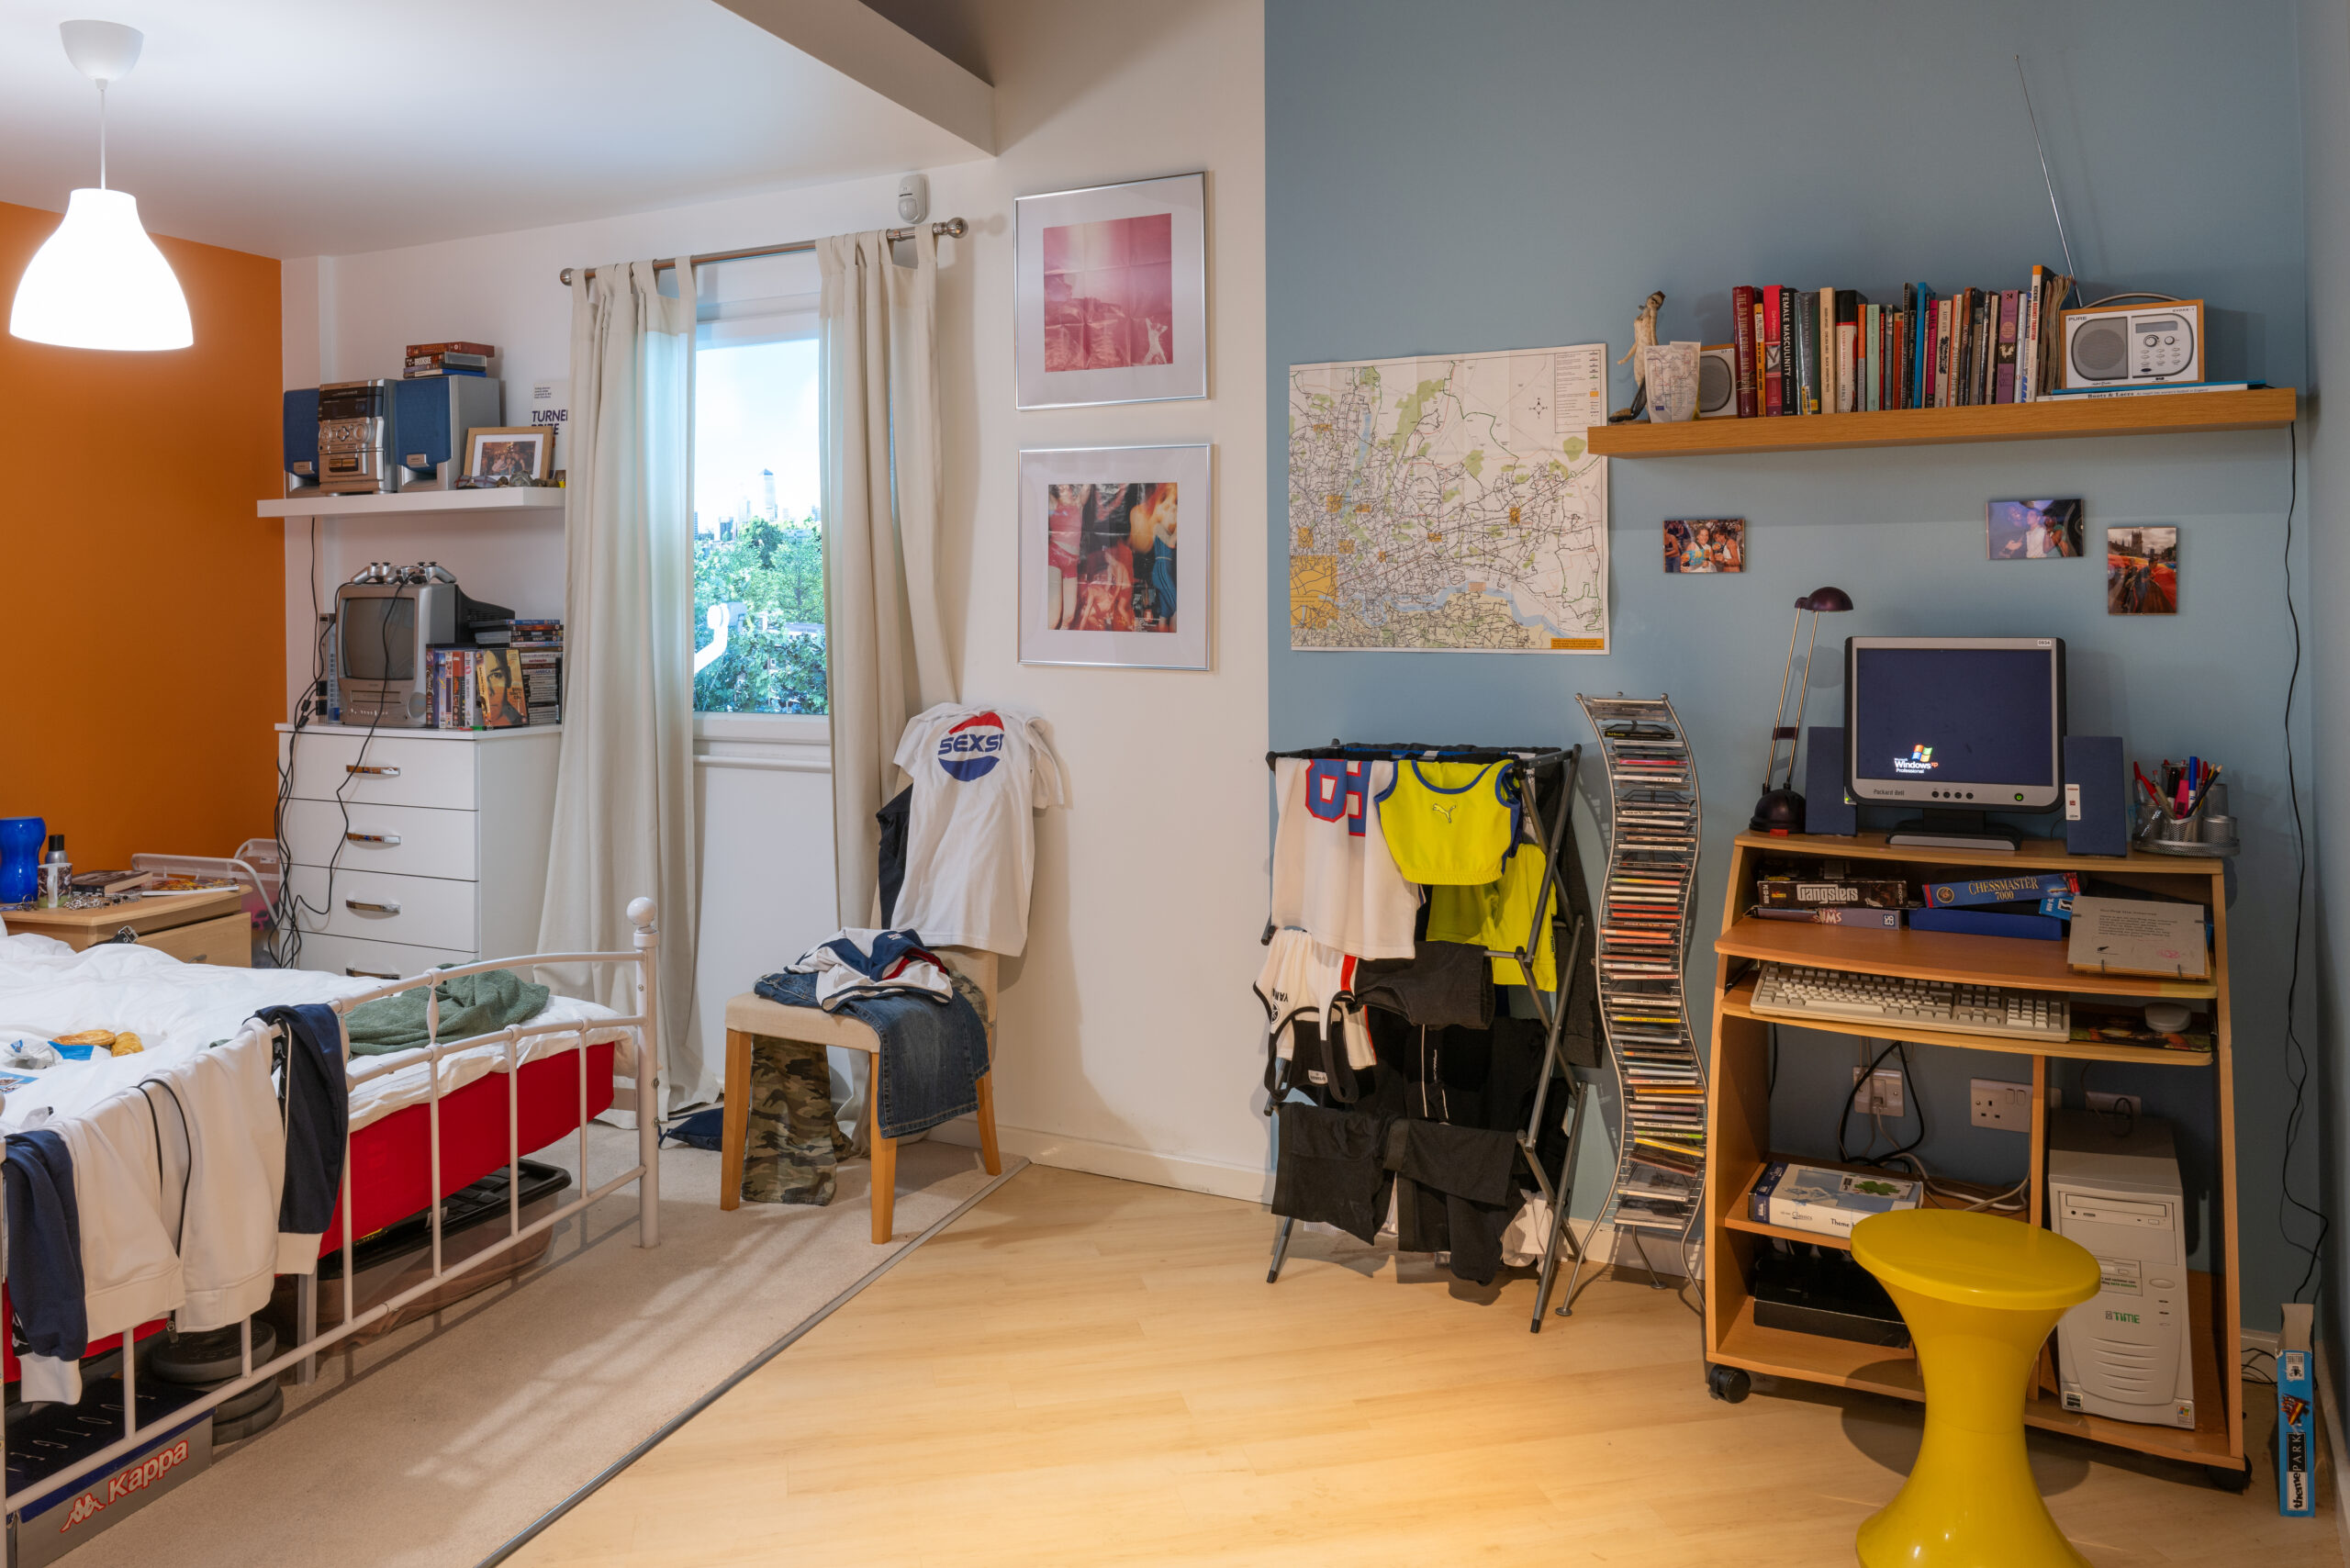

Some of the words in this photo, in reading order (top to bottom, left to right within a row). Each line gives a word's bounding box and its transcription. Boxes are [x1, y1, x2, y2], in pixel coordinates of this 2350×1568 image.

[1782, 292, 1791, 322] FEMALE
[1783, 324, 1791, 376] MASCULINITY
[937, 734, 1005, 756] SEXSI
[1894, 761, 1931, 769] Windows
[1796, 883, 1859, 904] Gangsters
[1968, 876, 2040, 896] CHESSMASTER
[1995, 891, 2015, 901] 7000
[1792, 1211, 1813, 1221] Classics
[1830, 1218, 1850, 1228] Theme
[2112, 1311, 2141, 1324] TIME
[2293, 1434, 2302, 1472] PARK
[107, 1439, 191, 1505] Kappa
[2293, 1472, 2302, 1508] theme
